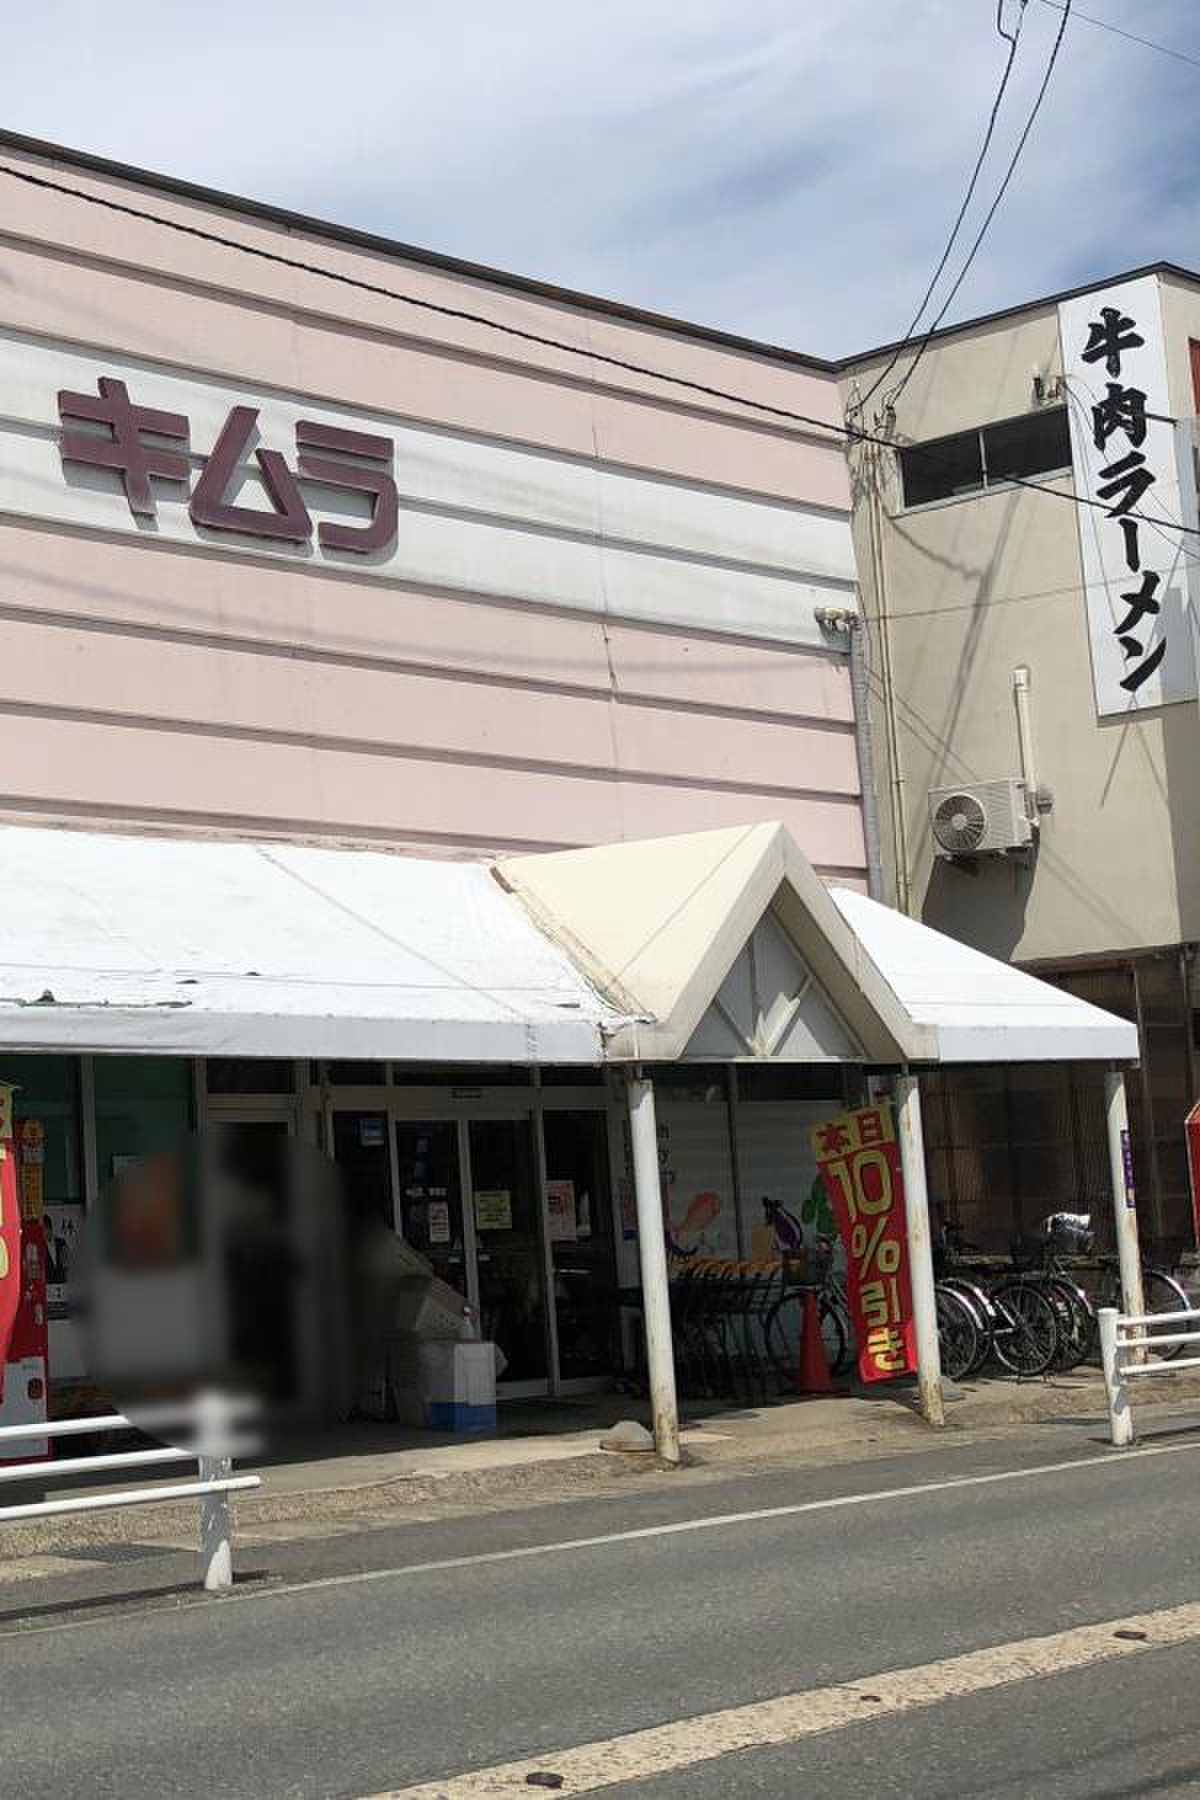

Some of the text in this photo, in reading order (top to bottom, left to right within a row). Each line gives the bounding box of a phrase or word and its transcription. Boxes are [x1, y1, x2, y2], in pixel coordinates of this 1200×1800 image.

[57, 376, 399, 558] キムラ
[1081, 306, 1166, 692] 牛肉ラーメン
[815, 1110, 882, 1154] 本日
